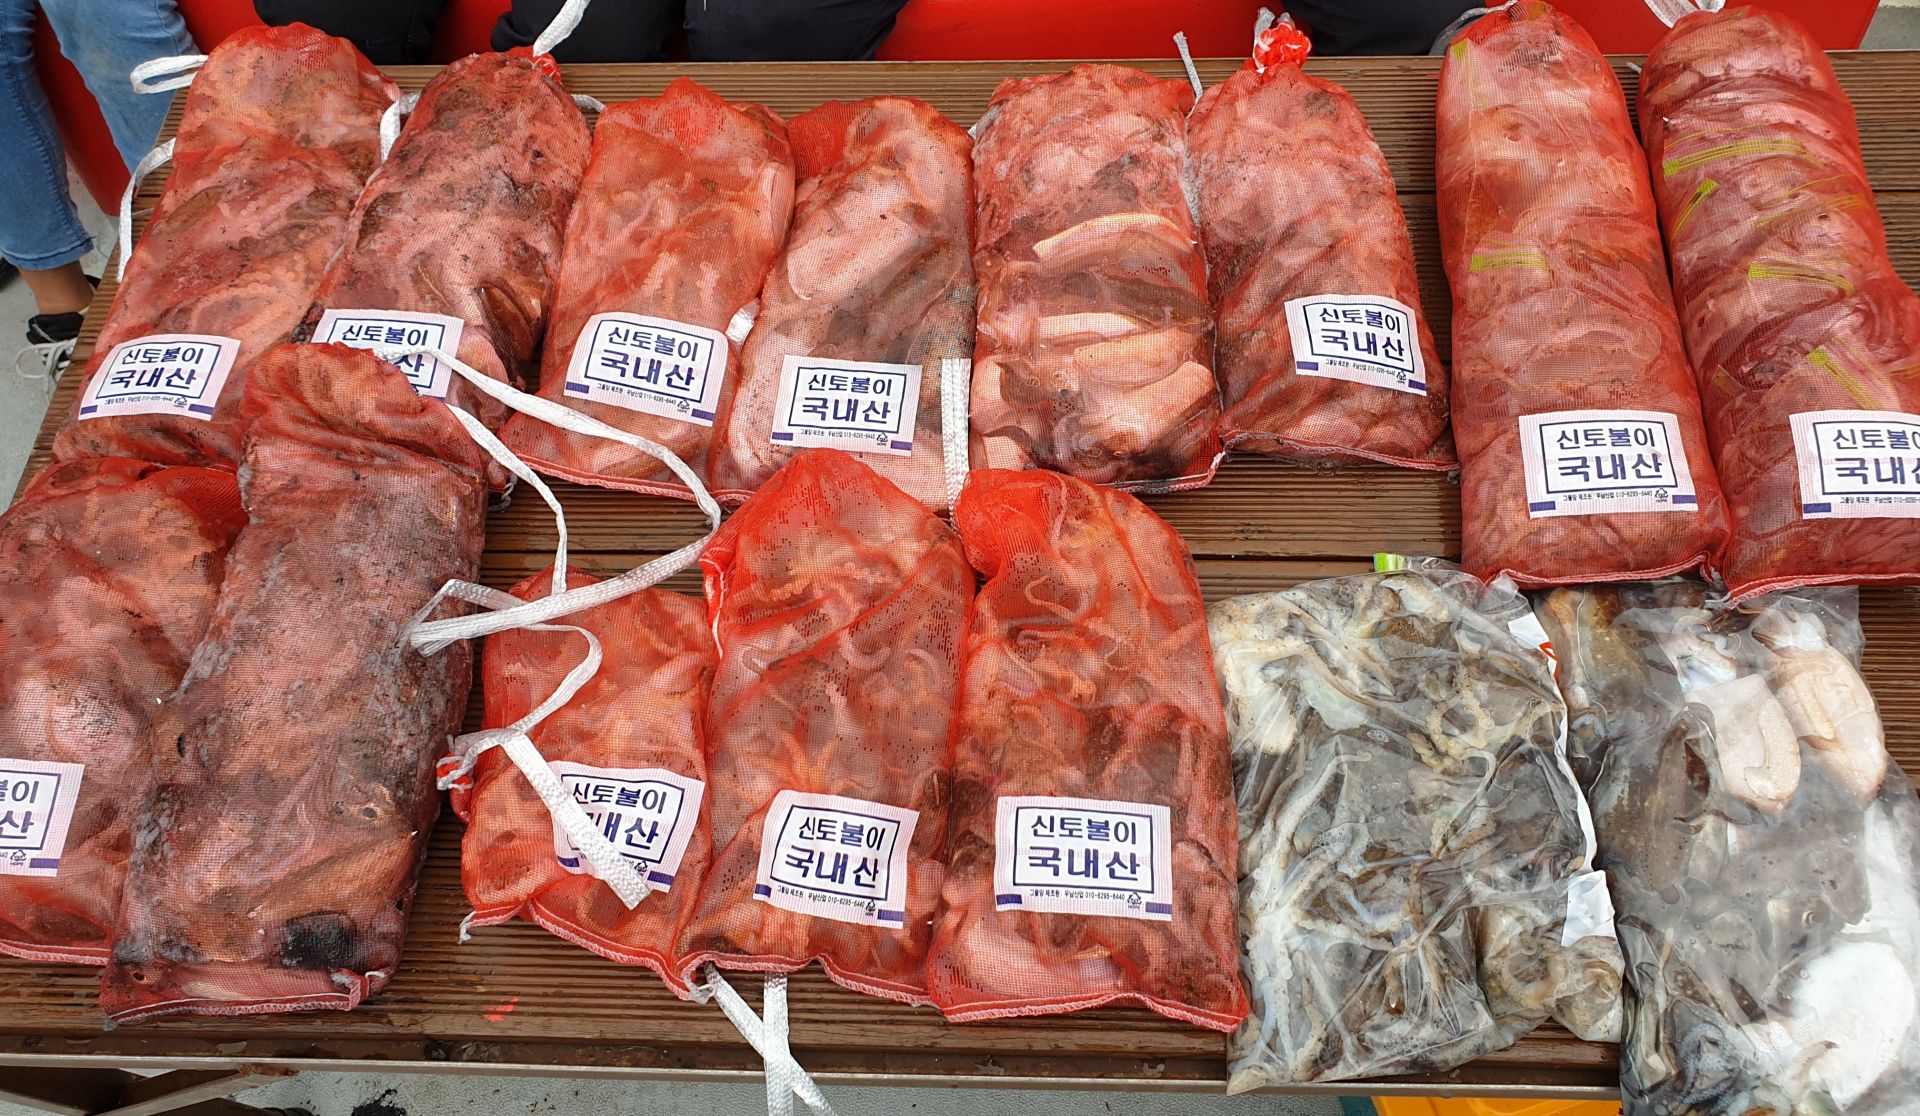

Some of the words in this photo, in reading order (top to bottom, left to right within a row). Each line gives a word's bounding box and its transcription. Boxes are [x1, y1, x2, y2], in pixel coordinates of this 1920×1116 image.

[342, 324, 428, 346] 신토불이
[1320, 308, 1400, 333] 신토불이
[121, 346, 204, 365] 신토불이
[608, 327, 698, 361] 신토불이
[1321, 328, 1405, 362] 국내산
[110, 367, 197, 389] 국내산
[600, 349, 695, 392] 국내산
[808, 374, 892, 396] 신토불이
[802, 397, 891, 424] 국내산
[1556, 427, 1655, 450] 신토불이
[1558, 453, 1662, 482] 국내산
[1834, 456, 1920, 484] 국내
[573, 782, 667, 814] 신토불이
[586, 811, 659, 850] 내산
[799, 816, 886, 851] 신토불이
[1031, 815, 1136, 845] 신토불이
[785, 844, 879, 889] 국내산
[1028, 846, 1140, 881] 국내산
